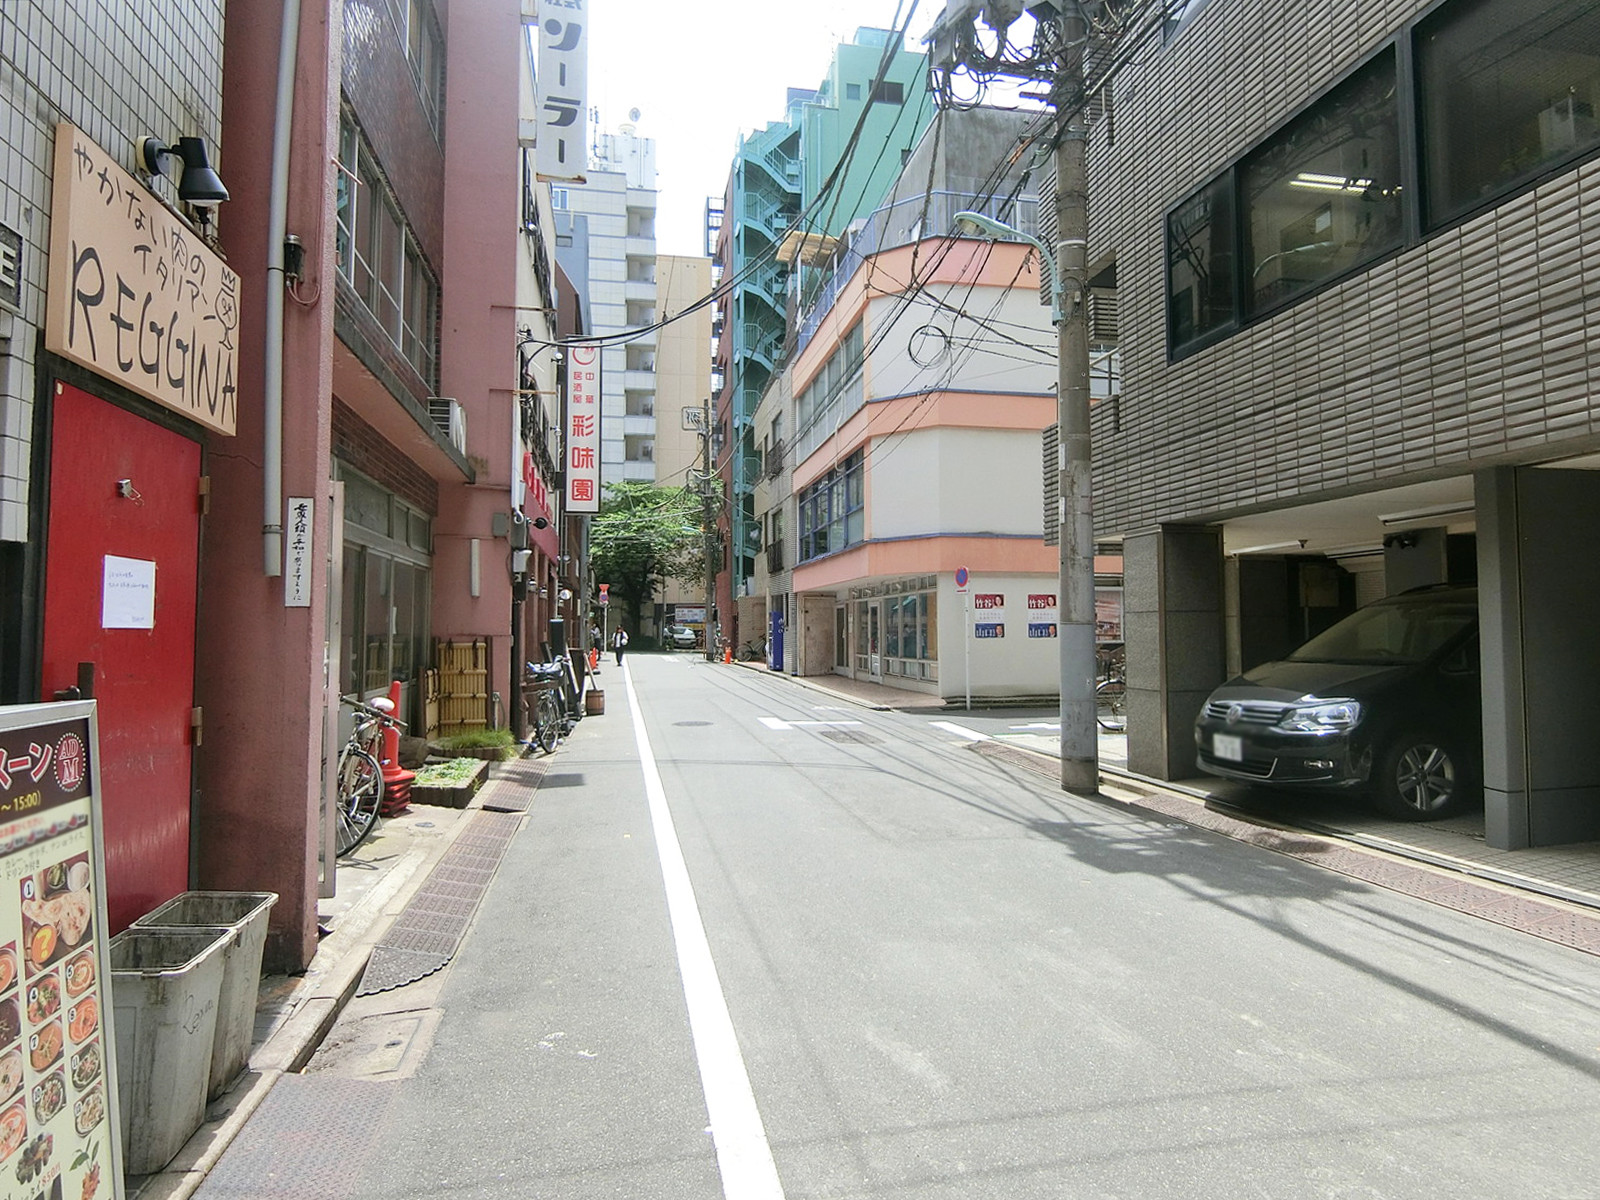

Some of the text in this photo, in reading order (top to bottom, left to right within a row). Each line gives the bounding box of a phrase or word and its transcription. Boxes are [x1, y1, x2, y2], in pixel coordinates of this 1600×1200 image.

[68, 240, 236, 424] REGGINA
[573, 371, 582, 404] 居酒屋
[571, 414, 594, 501] 彩味園
